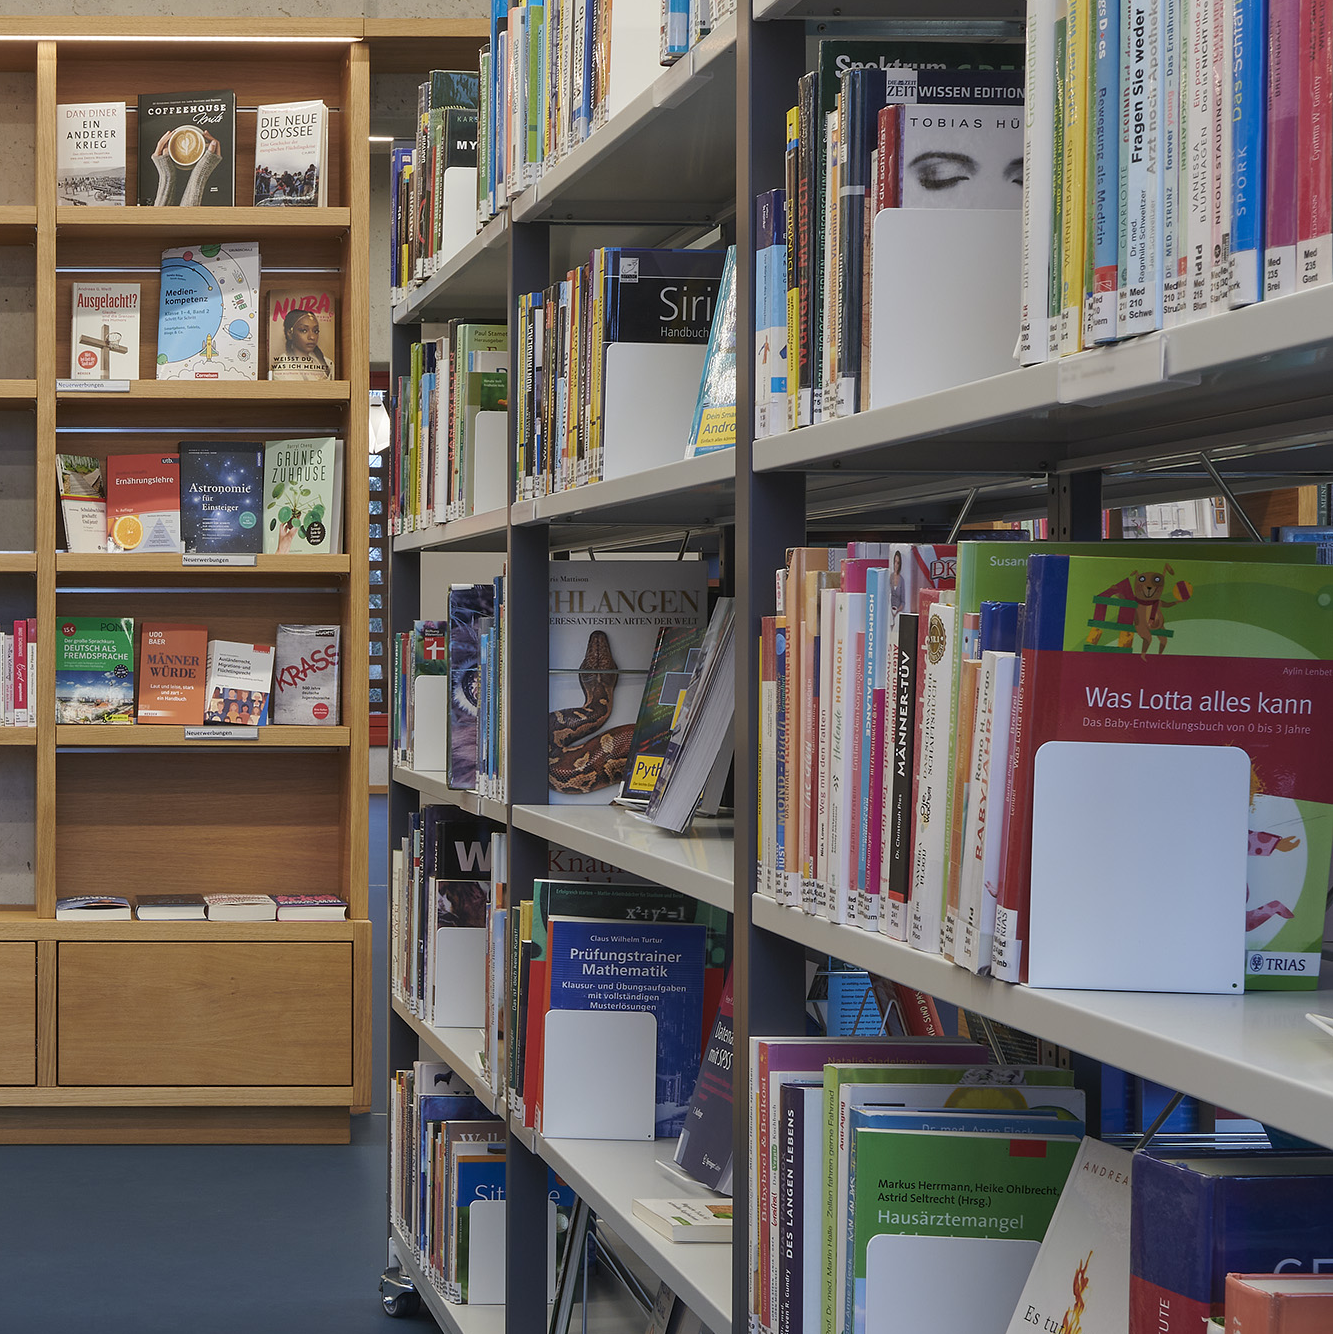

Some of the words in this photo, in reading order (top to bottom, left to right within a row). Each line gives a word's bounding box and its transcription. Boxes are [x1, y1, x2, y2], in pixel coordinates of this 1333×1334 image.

[1134, 8, 1145, 62] weder
[1133, 65, 1143, 93] Sie
[886, 85, 916, 97] ZEIT
[919, 85, 971, 98] WISSEN
[974, 87, 1025, 99] EDITION
[66, 109, 86, 118] DAN
[89, 109, 116, 117] DINER
[148, 104, 227, 115] COFFEEHOUSE
[83, 121, 100, 129] EIN
[261, 117, 281, 128] DIE
[285, 113, 317, 126] NEUE
[910, 118, 983, 128] TOBIAS
[67, 130, 116, 139] ANDERER
[260, 125, 313, 139] ODYSSEE
[1132, 96, 1144, 164] Fragen
[76, 141, 107, 149] KRIEG
[1236, 146, 1248, 216] SPORK
[166, 289, 198, 297] Medien-
[77, 294, 138, 310] Ausgelacht!?
[165, 296, 208, 306] kompetenz
[273, 294, 331, 321] NURA
[660, 286, 712, 321] Siri
[660, 326, 709, 338] Handbuch
[276, 449, 322, 467] GRÜNES
[116, 476, 174, 486] Ernährungslehre
[272, 465, 326, 483] ZUHAUSE
[189, 483, 251, 495] Astronomie
[202, 503, 239, 513] Einsteiger
[622, 617, 652, 626] ARTEN
[654, 617, 671, 626] DER
[673, 617, 698, 626] WELT
[64, 645, 98, 653] DEUTSCH
[101, 645, 116, 653] ALS
[64, 652, 128, 660] FREMDSPRACHE
[147, 653, 199, 667] MÄNNER
[150, 666, 196, 679] WÜRDE
[276, 645, 339, 693] KRASS
[1086, 686, 1132, 708] Was
[1139, 687, 1192, 711] Lotta
[1200, 690, 1251, 713] alles
[1257, 692, 1312, 715] kann
[898, 650, 910, 777] MÄNNER-TÜV
[1082, 717, 1101, 728] Das
[1104, 717, 1224, 733] Baby-Entwicklungsbuch
[1227, 722, 1245, 732] von
[1248, 722, 1254, 733] 0
[1257, 722, 1273, 733] bis
[1276, 723, 1282, 734] 3
[1285, 723, 1311, 735] Jahre
[975, 699, 993, 862] BABYJAHRE
[590, 935, 609, 944] Claus
[611, 935, 640, 943] Wilhelm
[642, 936, 663, 944] Turtur
[570, 948, 681, 964] Prüfungstrainer
[582, 964, 668, 978] Mathematik
[1266, 958, 1306, 972] TRIAS
[562, 981, 596, 990] Klausur-
[598, 983, 614, 991] und
[616, 982, 687, 994] Übungsaufgaben
[588, 992, 601, 1000] mit
[604, 992, 659, 1002] vollständigen
[590, 1001, 657, 1012] Musterlösungen
[878, 1179, 916, 1190] Markus
[918, 1181, 973, 1194] Herrmann,
[975, 1183, 1003, 1194] Heike
[1005, 1184, 1060, 1197] Ohlbrecht,
[877, 1192, 907, 1203] Astrid
[910, 1194, 955, 1205] Seltrecht
[957, 1195, 992, 1208] (Hrsg.)
[877, 1208, 1024, 1231] Hausärztemangel
